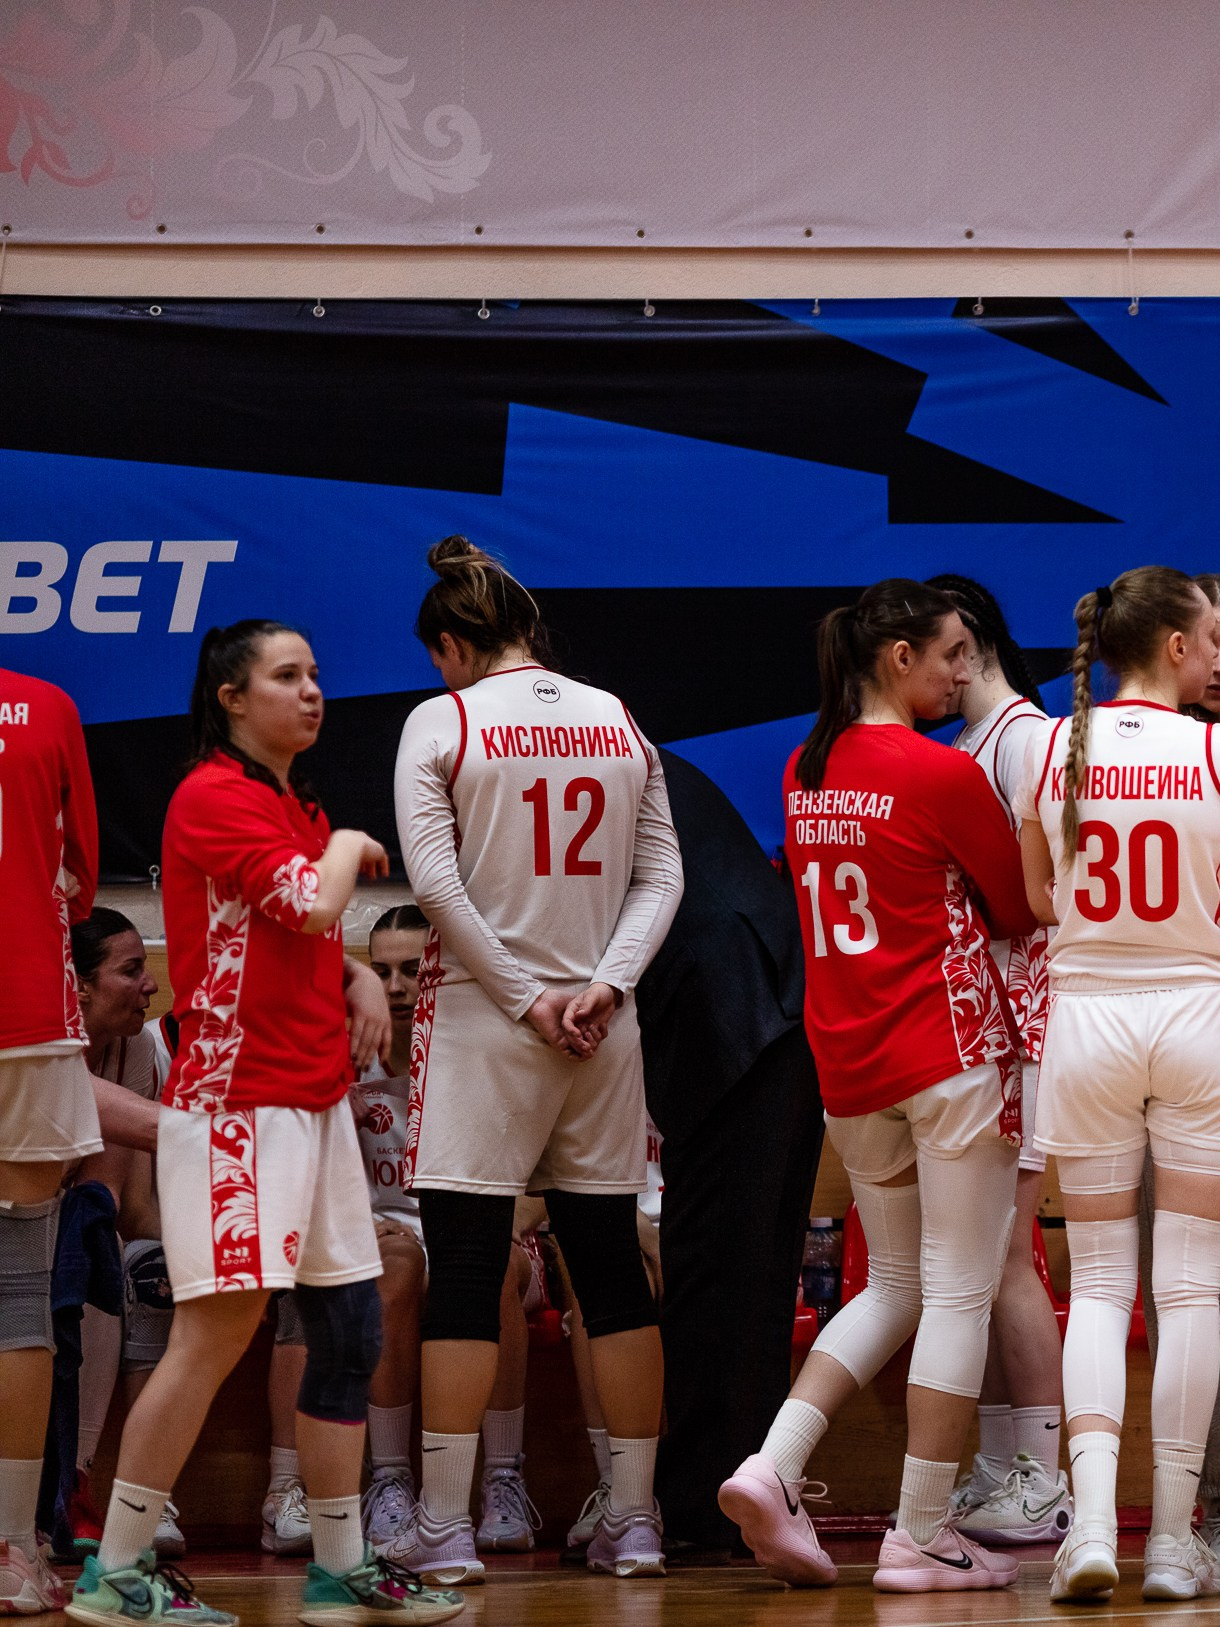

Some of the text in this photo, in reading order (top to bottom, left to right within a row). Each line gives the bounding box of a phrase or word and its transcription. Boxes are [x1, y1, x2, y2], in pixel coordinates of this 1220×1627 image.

[1118, 720, 1141, 729] РФБ
[481, 725, 634, 761] КИСЛЮНИНА
[1051, 765, 1204, 802] КИВОШЕИНА
[788, 788, 895, 821] ПЕНЗЕНСКАЯ
[521, 776, 606, 877] 12
[795, 818, 867, 847] ОБЛАСТЬ
[1074, 820, 1180, 923] 30
[801, 860, 880, 958] 13
[220, 1256, 253, 1267] SPORT
